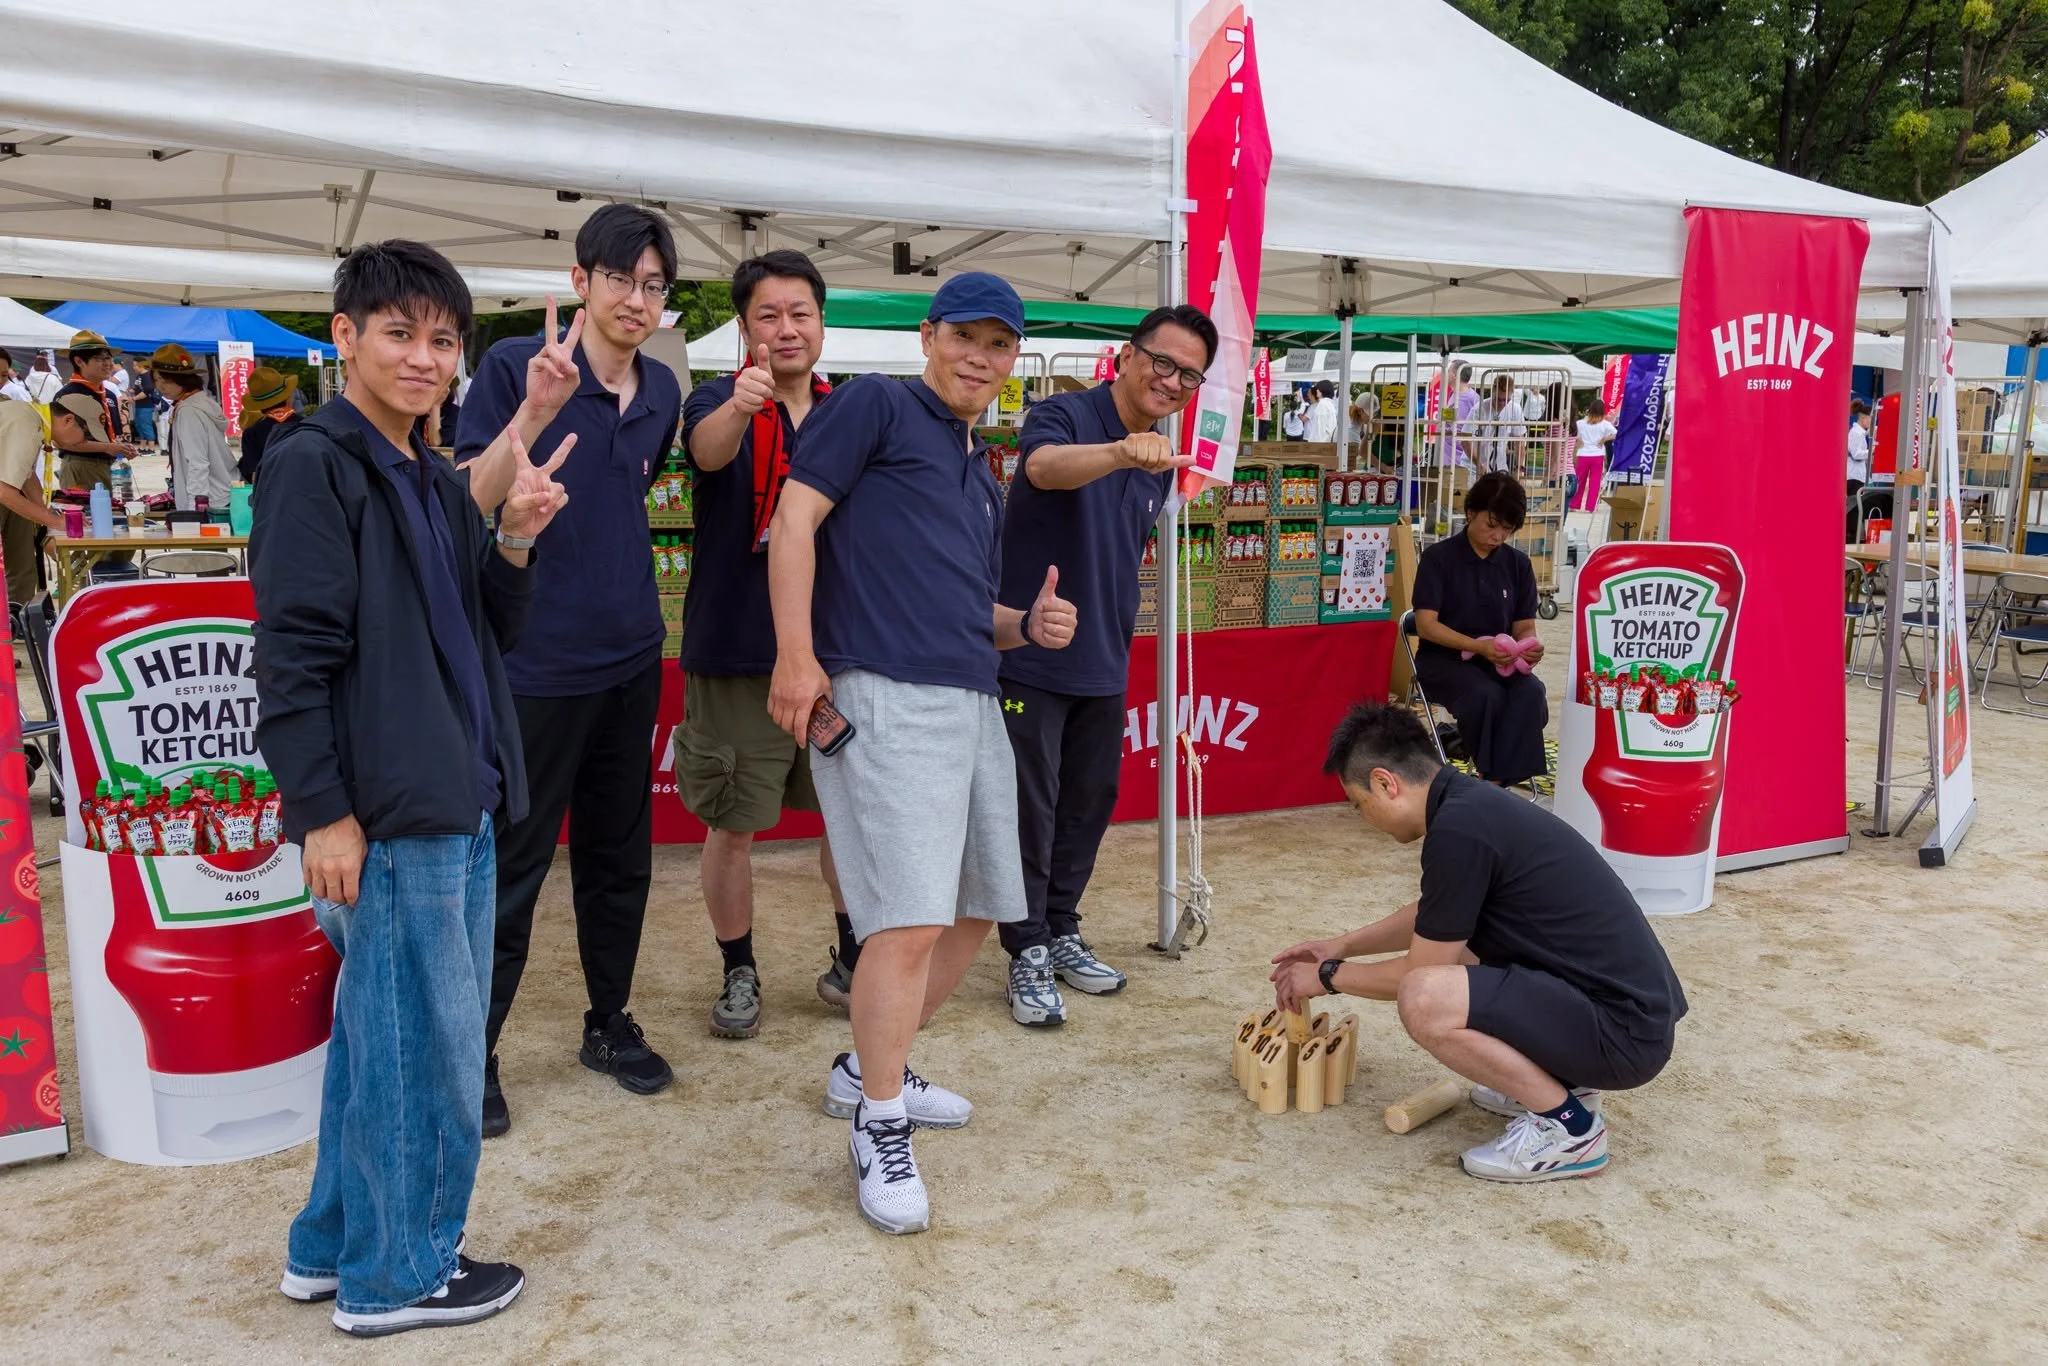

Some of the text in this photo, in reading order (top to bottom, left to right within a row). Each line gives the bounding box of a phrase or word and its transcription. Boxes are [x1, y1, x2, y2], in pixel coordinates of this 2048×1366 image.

[1711, 312, 1834, 379] HEINZ
[1770, 379, 1792, 390] 1869
[227, 361, 240, 434] ファーストエイド
[1640, 434, 1656, 473] 2026
[1619, 582, 1699, 612] HEINZ
[1611, 619, 1701, 641] TOMATO
[1613, 641, 1693, 659] KETCHUP
[208, 683, 238, 693] 1869
[128, 697, 260, 737] TOMAT
[1649, 718, 1671, 735] GROWN
[141, 730, 259, 765] KETCHU
[1663, 740, 1684, 749] 460g
[651, 783, 680, 794] 869
[133, 820, 150, 830] HEIN
[167, 822, 189, 831] HEINZ
[227, 819, 250, 829] HEINZ
[195, 863, 234, 883] GROWN
[235, 871, 257, 883] NOT
[225, 889, 260, 902] 460g
[1261, 1009, 1277, 1028] 6
[1237, 1021, 1255, 1043] 12
[1251, 1033, 1272, 1054] 10
[1262, 1042, 1282, 1064] 11
[1302, 1042, 1320, 1061] 5
[1325, 1036, 1342, 1055] 8
